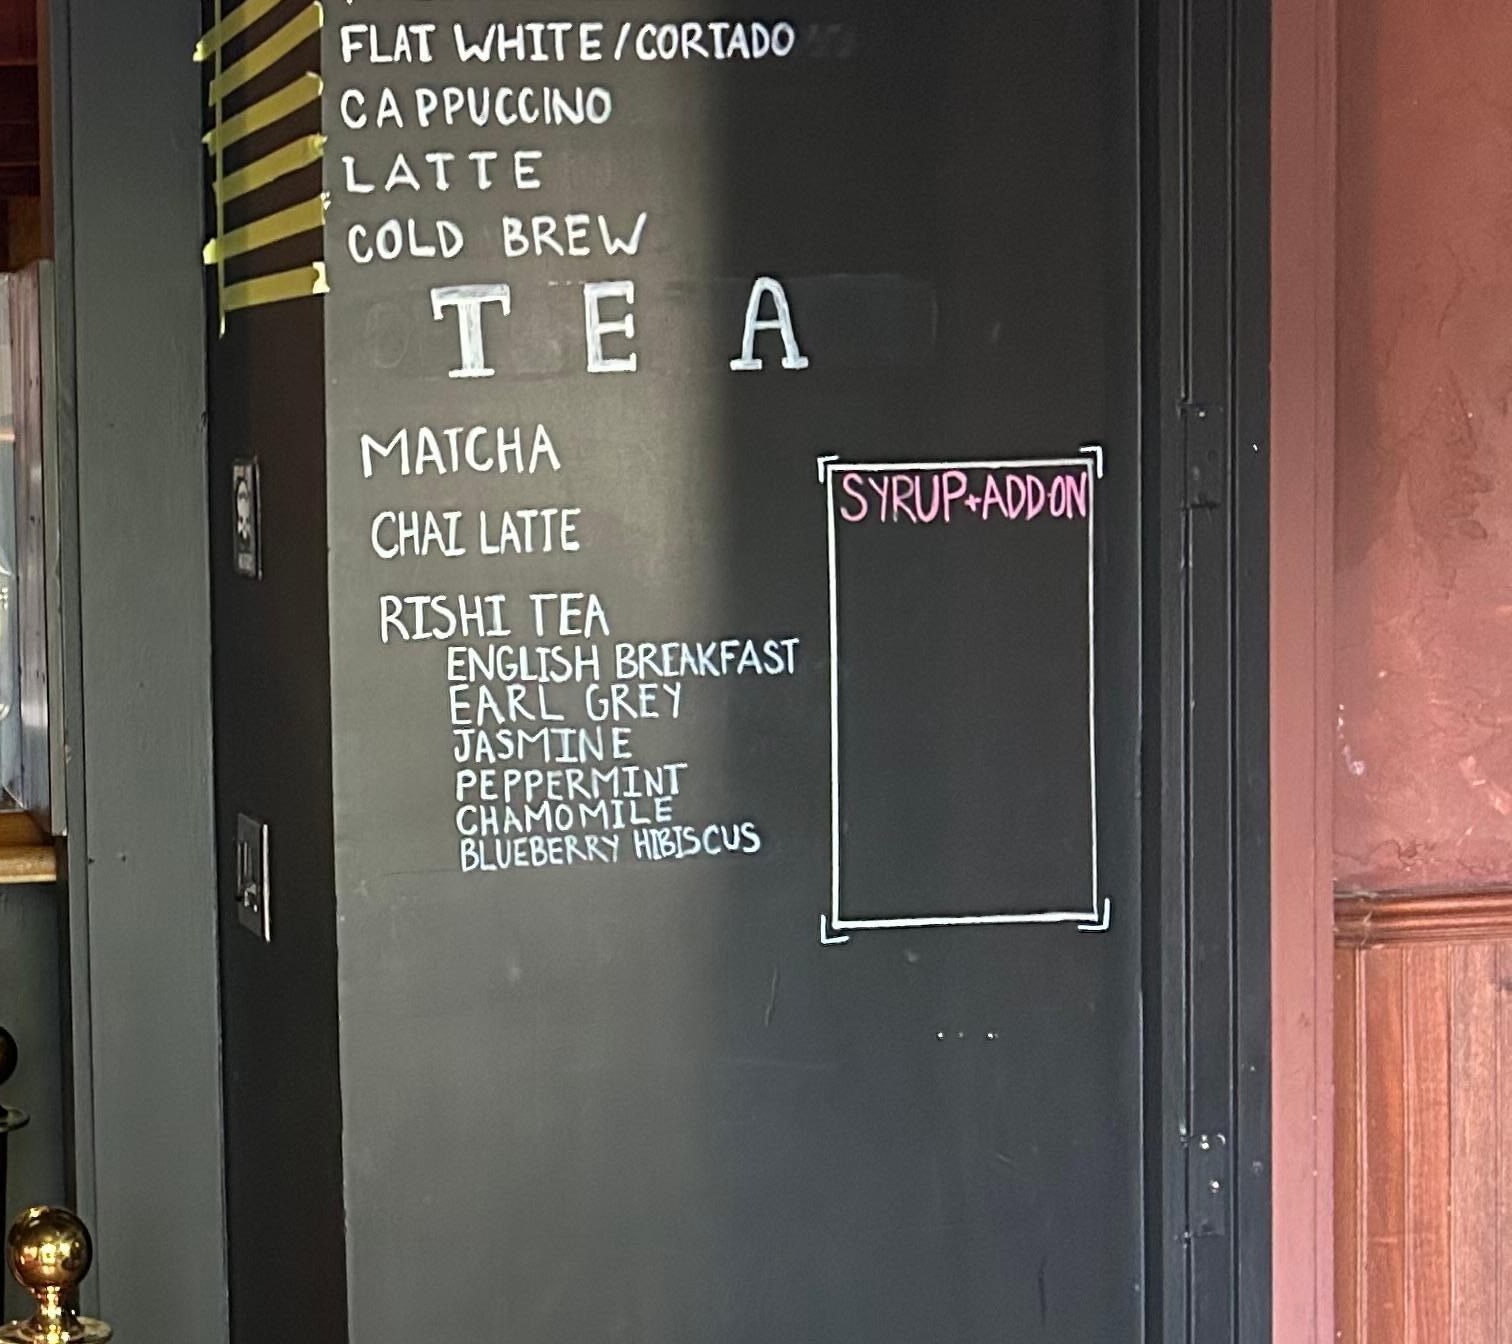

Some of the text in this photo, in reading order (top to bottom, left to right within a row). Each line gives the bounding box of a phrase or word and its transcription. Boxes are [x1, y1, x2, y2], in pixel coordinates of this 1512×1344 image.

[340, 23, 436, 64] FLAT
[340, 86, 613, 130] CAPPUCCINO
[341, 149, 543, 194] LATTE
[347, 213, 649, 265] COLD BREW
[430, 276, 810, 380] TEA
[361, 422, 561, 480] MATCHA
[371, 508, 581, 560] CHAI LATTE
[379, 592, 609, 643] RISHI TEA
[447, 637, 799, 685] ENGLISH BREAKFAST
[450, 681, 683, 727] EARL GREY
[451, 727, 633, 764] JASMINE
[455, 761, 688, 802] PEPPERMINT
[455, 798, 675, 838] CHAMOMILE
[460, 823, 761, 874] BLUEBERRY HIBISCUS
